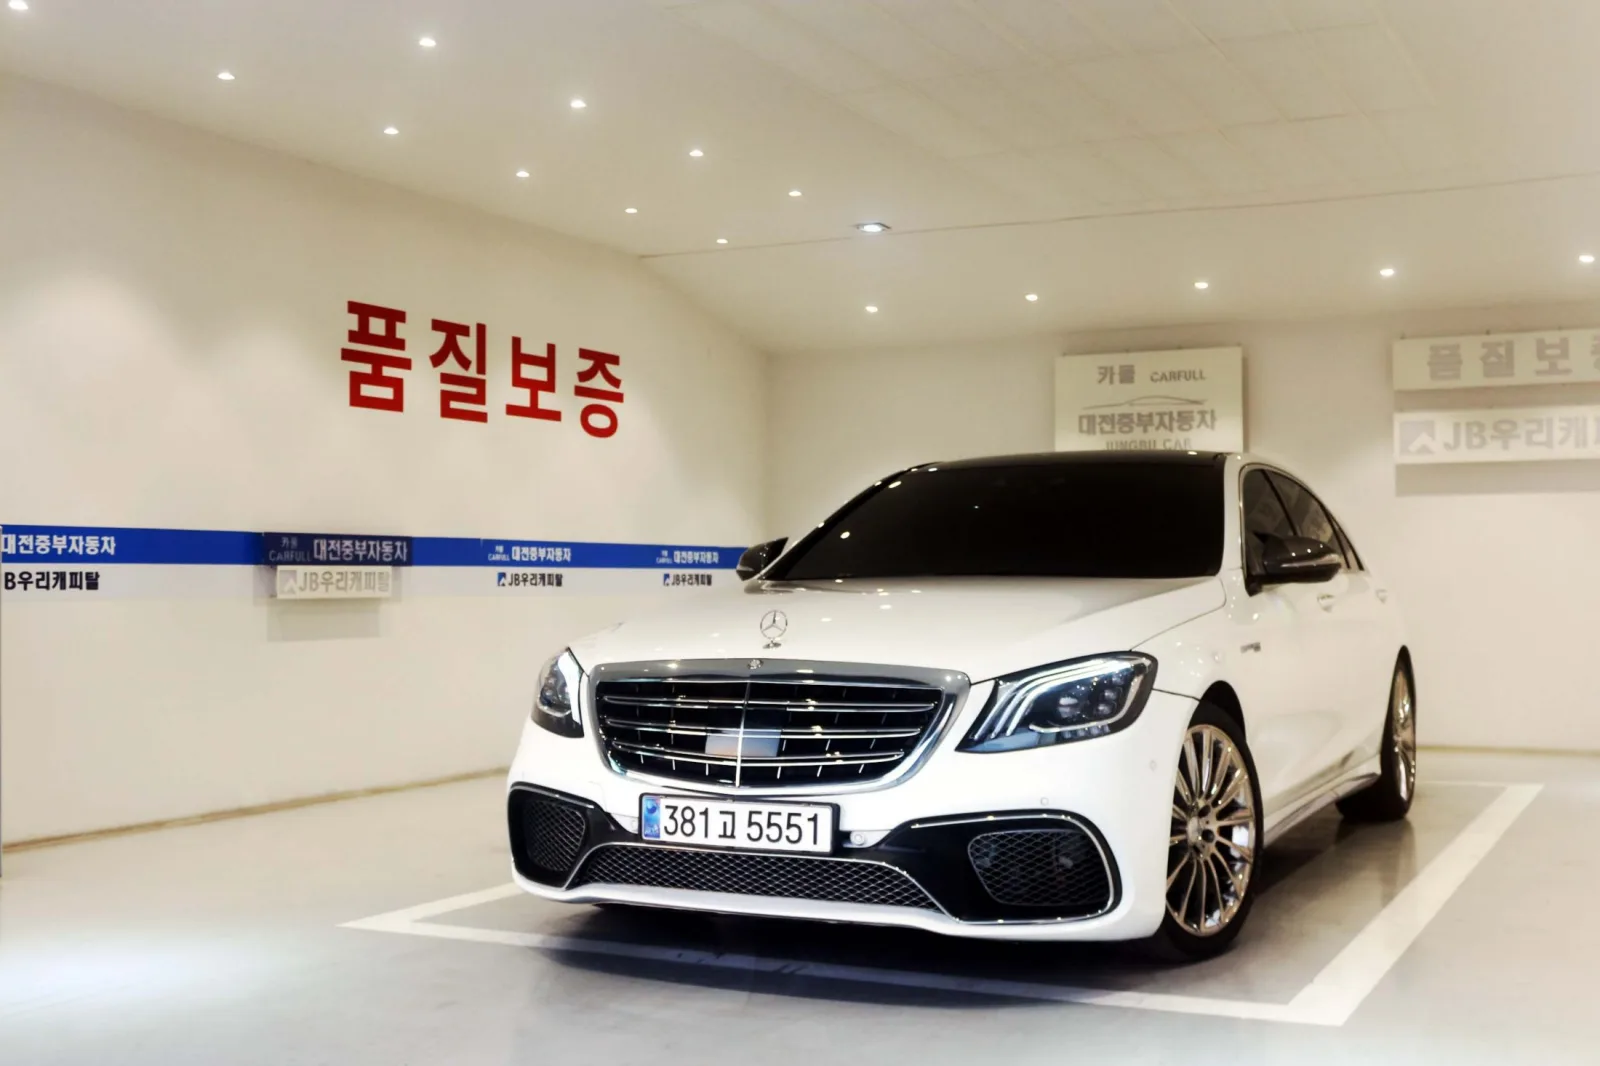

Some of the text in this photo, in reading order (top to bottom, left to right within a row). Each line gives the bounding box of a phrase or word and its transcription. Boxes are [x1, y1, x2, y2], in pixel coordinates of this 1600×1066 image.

[341, 300, 624, 438] 품질보증
[1427, 335, 1600, 380] 품질보
[1150, 369, 1206, 383] CARFULL
[1078, 408, 1217, 435] 대전중부자동차
[1443, 415, 1600, 451] JB우리캐
[1, 533, 116, 556] 대전중부자동차
[313, 538, 408, 562] 대전중부자동차
[511, 546, 571, 562] 대전중부자동차
[299, 570, 391, 593] JB우리캐피탈
[508, 572, 563, 587] JB우리캐피탈
[746, 810, 818, 846] 5551
